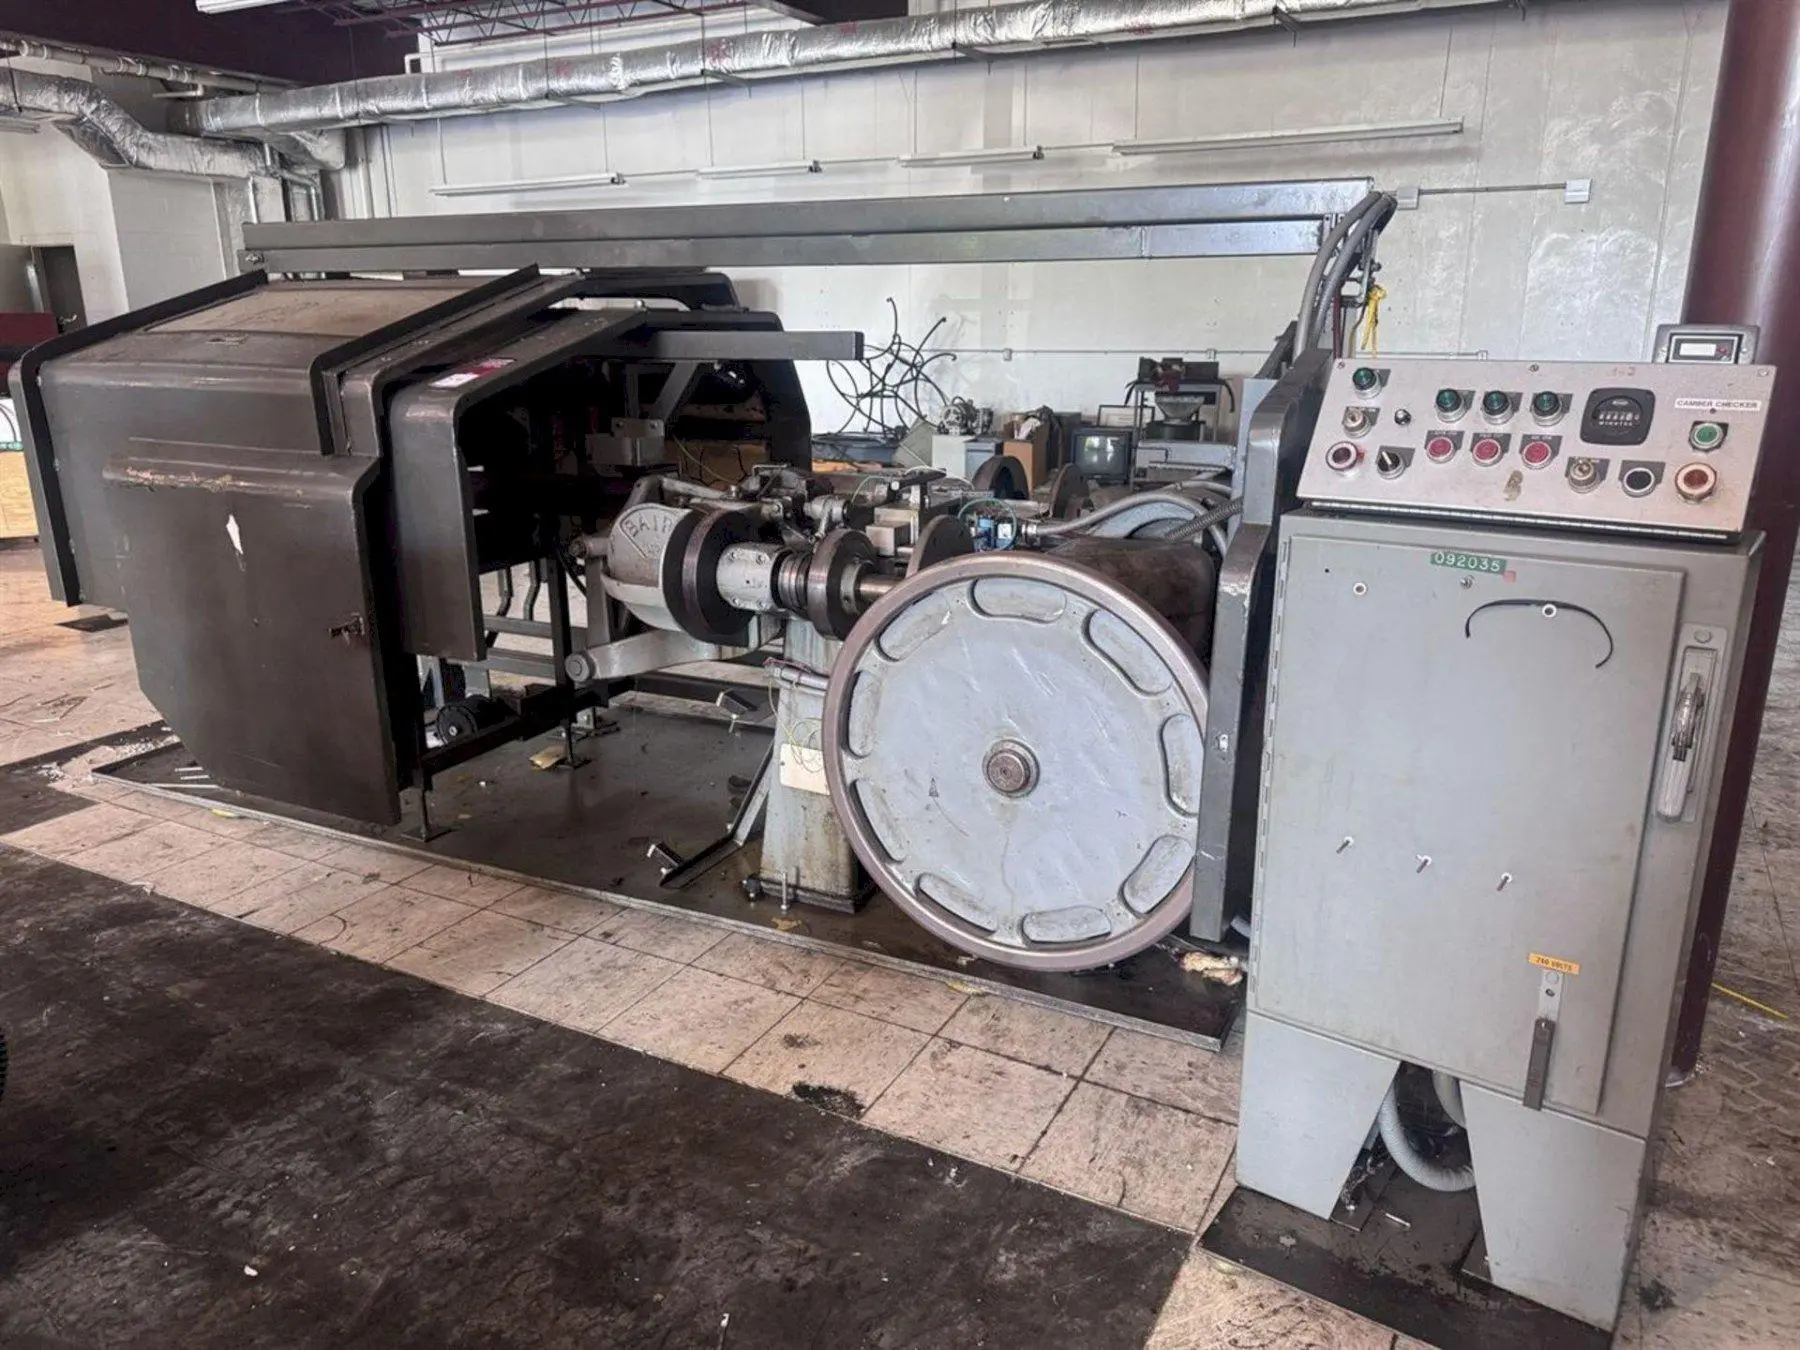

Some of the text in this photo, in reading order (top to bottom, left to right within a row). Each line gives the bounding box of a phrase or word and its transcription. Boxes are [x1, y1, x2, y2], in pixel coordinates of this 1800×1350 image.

[1676, 399, 1758, 409] CAMBER CHECKER
[1434, 551, 1501, 573] 092035
